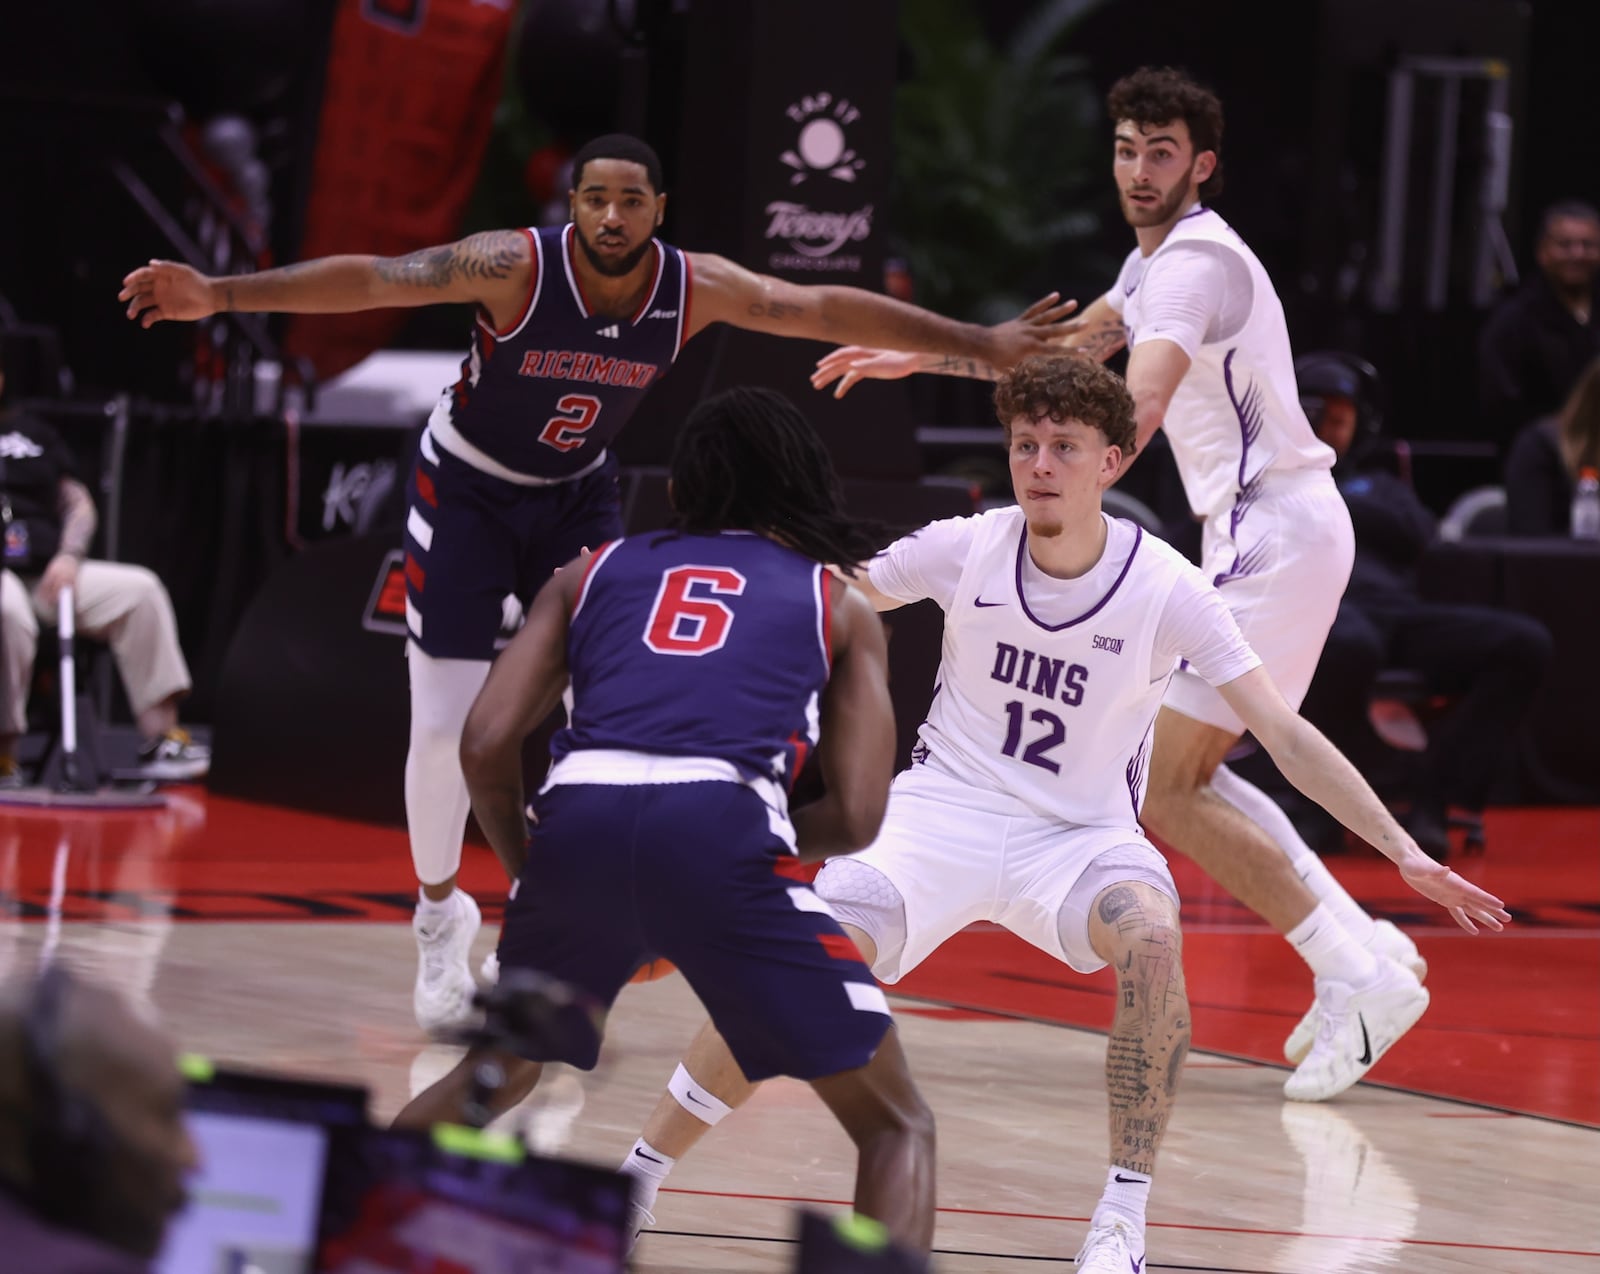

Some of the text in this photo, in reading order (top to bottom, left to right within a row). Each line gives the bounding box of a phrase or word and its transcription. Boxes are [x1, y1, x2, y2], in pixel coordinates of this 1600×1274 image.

[538, 393, 602, 452] 2
[642, 564, 746, 656] 6
[990, 641, 1089, 707] DINS
[1001, 700, 1066, 775] 12
[1123, 990, 1135, 1008] 12
